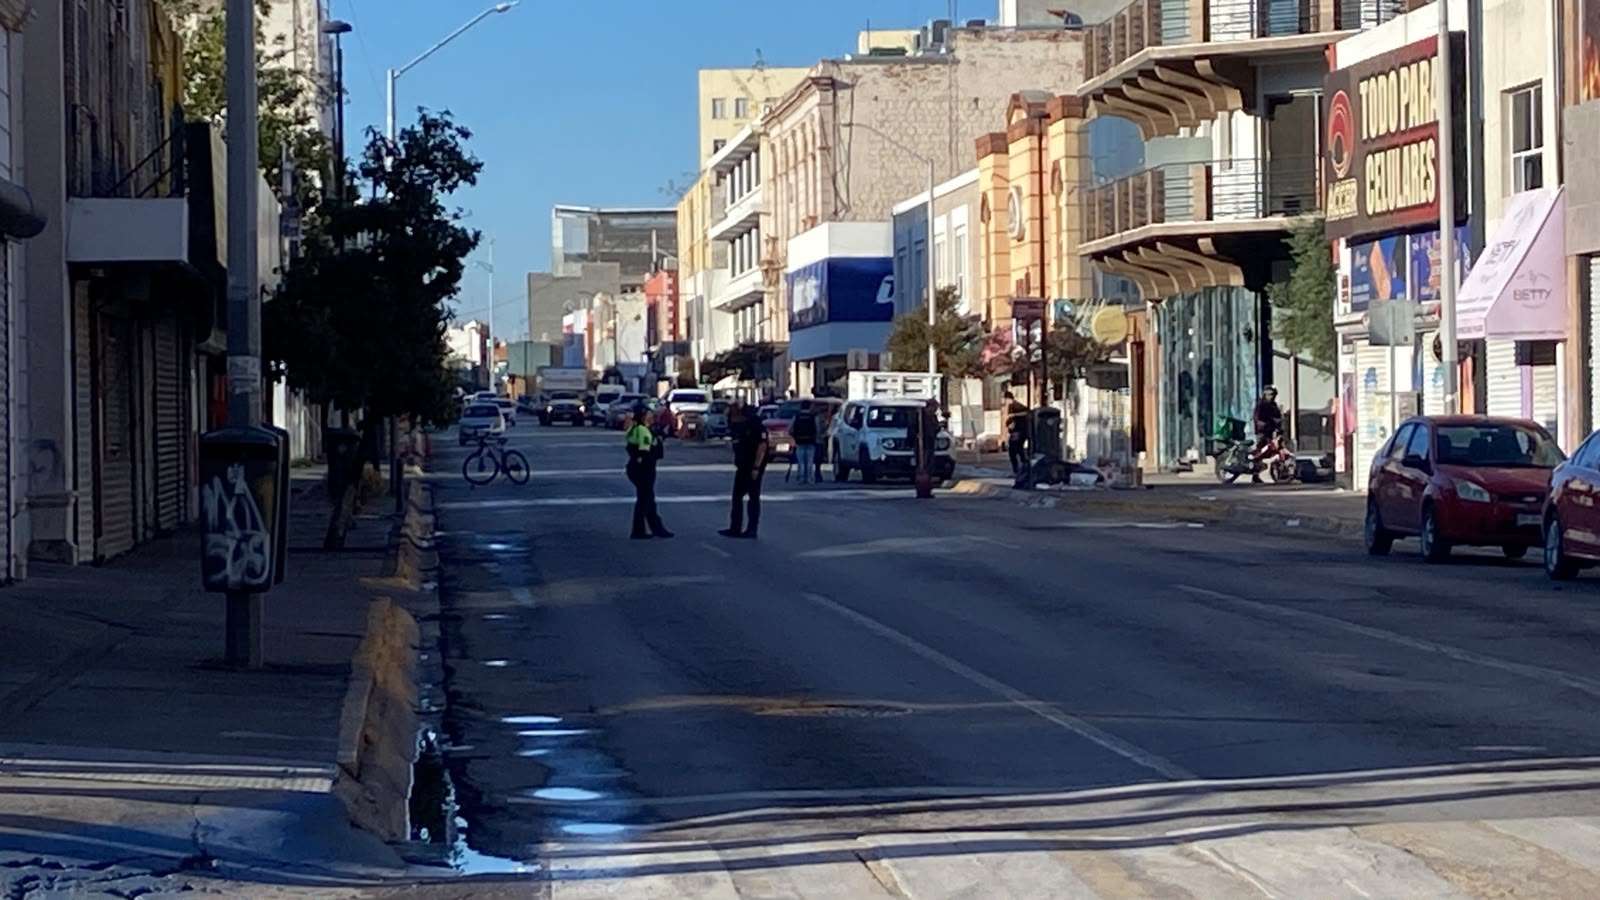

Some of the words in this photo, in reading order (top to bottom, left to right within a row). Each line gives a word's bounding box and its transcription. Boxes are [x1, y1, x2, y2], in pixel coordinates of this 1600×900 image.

[1359, 70, 1398, 140] TODO
[1400, 56, 1439, 131] PARA
[1365, 138, 1435, 215] CELULARES
[1513, 288, 1552, 301] BETTY
